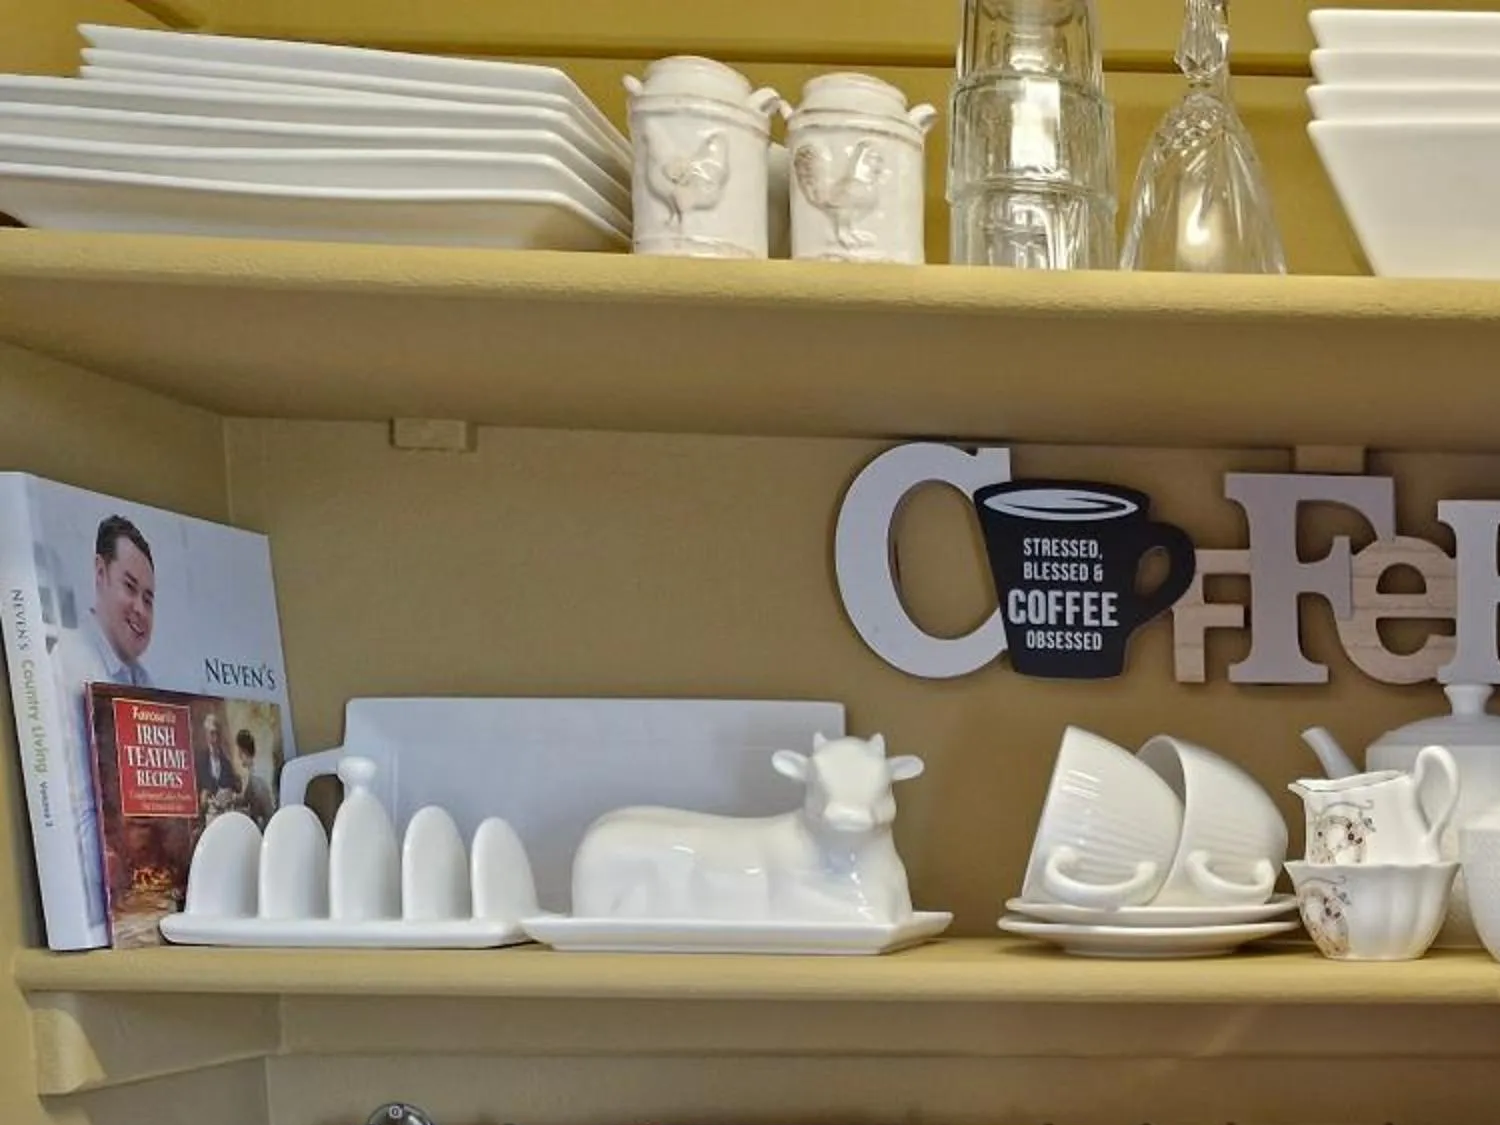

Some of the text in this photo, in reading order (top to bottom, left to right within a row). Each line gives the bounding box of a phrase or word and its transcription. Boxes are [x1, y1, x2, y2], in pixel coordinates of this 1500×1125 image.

[1023, 538, 1103, 560] STRESSED,
[1023, 561, 1104, 582] BLESSED &
[1007, 588, 1119, 627] COFFEE
[1026, 630, 1103, 650] OBSESSED
[205, 657, 277, 692] NEVEN'S
[136, 724, 176, 747] IRISH
[124, 745, 189, 770] TEATIME
[137, 770, 183, 789] RECIPES
